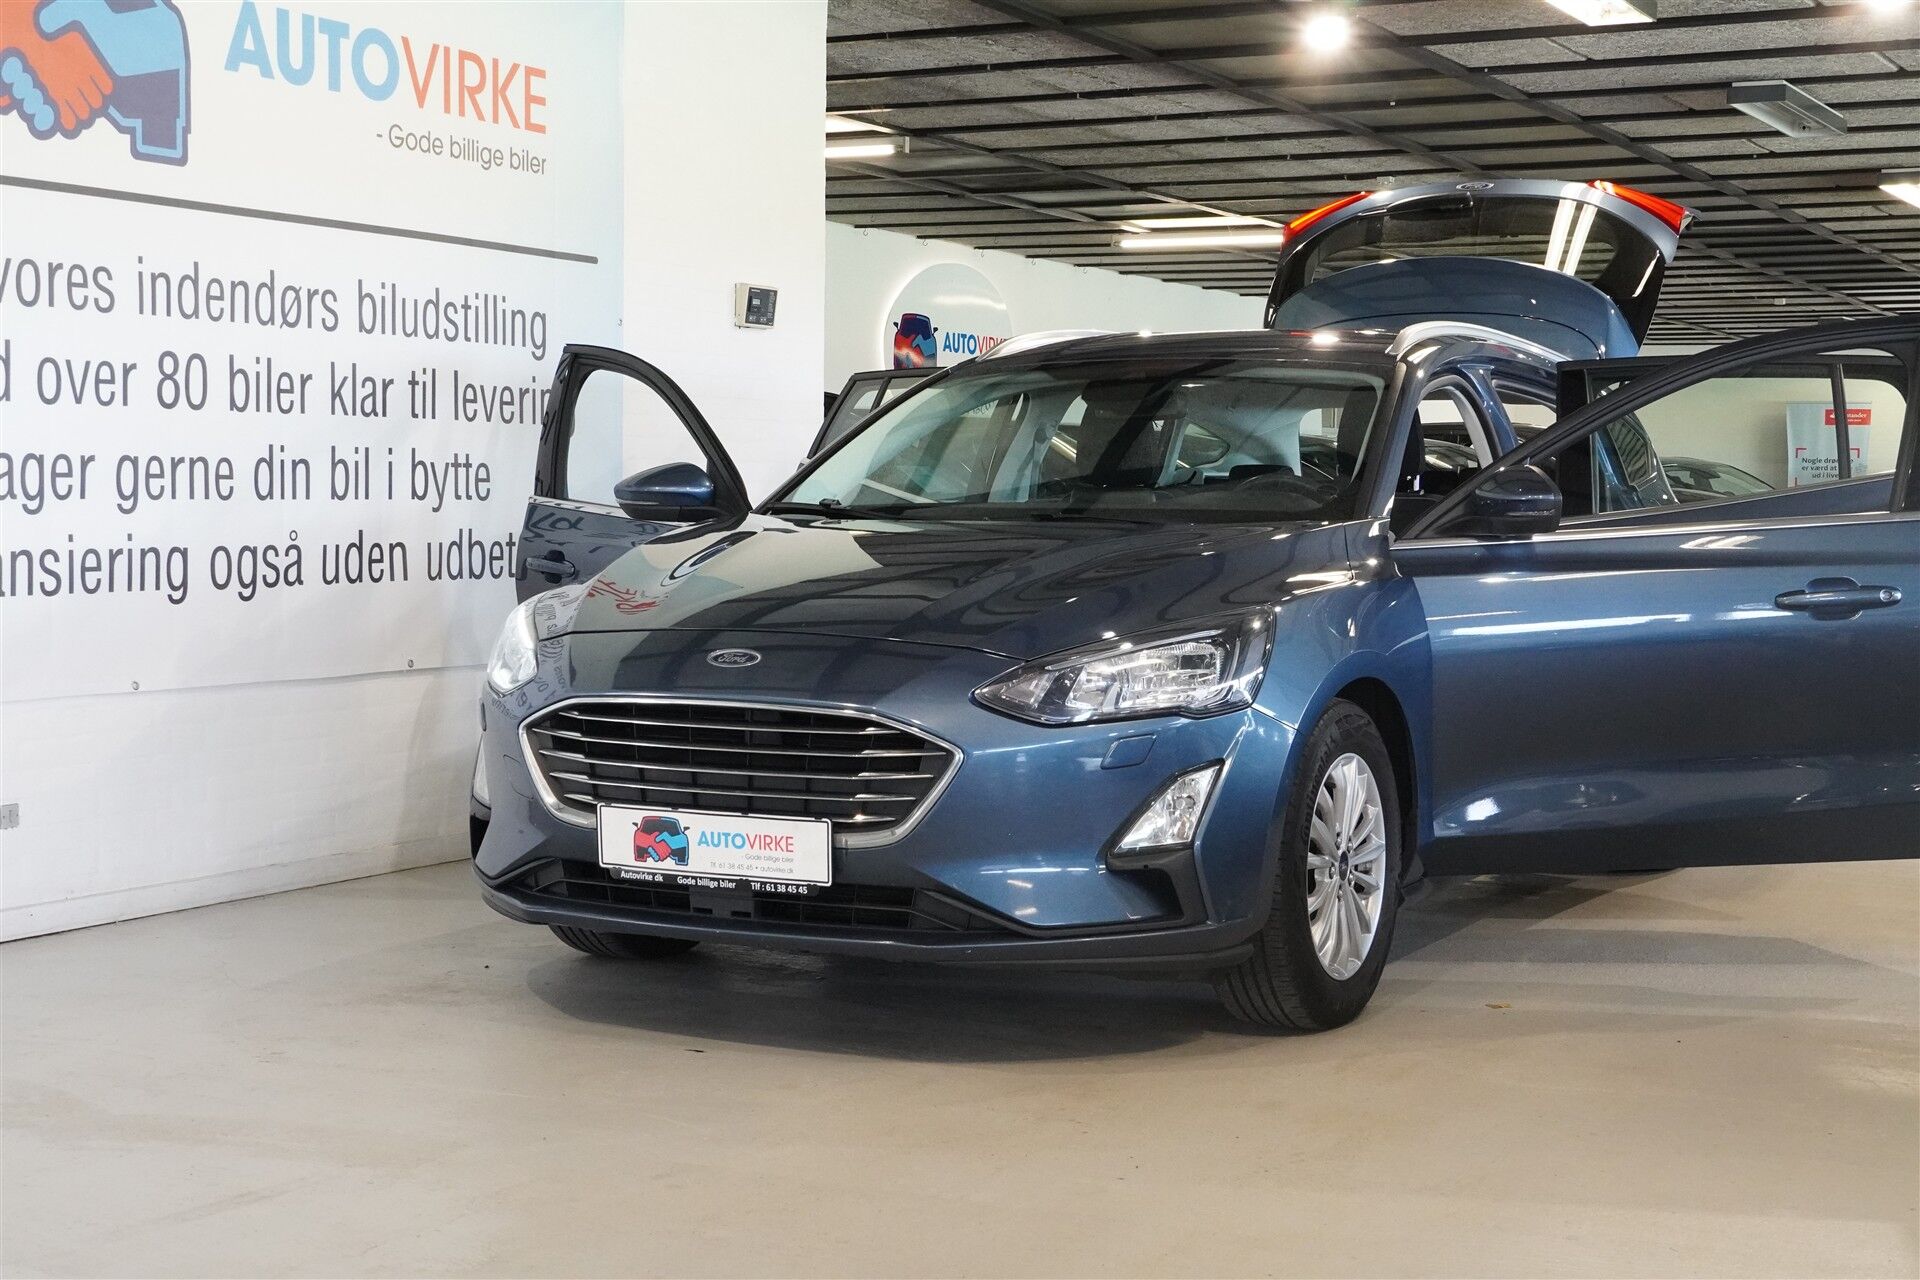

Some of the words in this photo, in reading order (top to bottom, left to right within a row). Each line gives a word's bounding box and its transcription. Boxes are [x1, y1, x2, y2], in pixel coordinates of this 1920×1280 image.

[224, 0, 546, 134] AUTOVIRKE
[388, 123, 444, 156] Gode
[450, 135, 504, 171] billige
[509, 147, 547, 175] biler
[137, 256, 339, 332] indendørs
[358, 279, 547, 361] biludstilling
[37, 355, 136, 407] over
[157, 350, 208, 411] 80
[229, 354, 313, 415] biler
[330, 362, 395, 419] klar
[408, 367, 437, 421] til
[0, 451, 95, 515] ager
[116, 453, 234, 513] gerne
[254, 445, 310, 501] din
[330, 446, 370, 501] bil
[388, 447, 394, 501] i
[410, 447, 491, 513] bytte
[1802, 457, 1823, 465] Nogle
[0, 533, 189, 604] nsiering
[210, 530, 303, 602] også
[322, 530, 408, 585] uden
[697, 830, 794, 853] AUTOVIRKE
[744, 853, 762, 861] Gode
[763, 854, 781, 864] billige
[781, 855, 794, 863] biler
[620, 870, 653, 881] Autovirke
[677, 876, 696, 886] Gode
[697, 877, 718, 889] billige
[719, 879, 737, 889] biler
[766, 883, 775, 892] 61
[777, 884, 786, 893] 38
[787, 884, 797, 894] 45
[798, 885, 808, 895] 45
